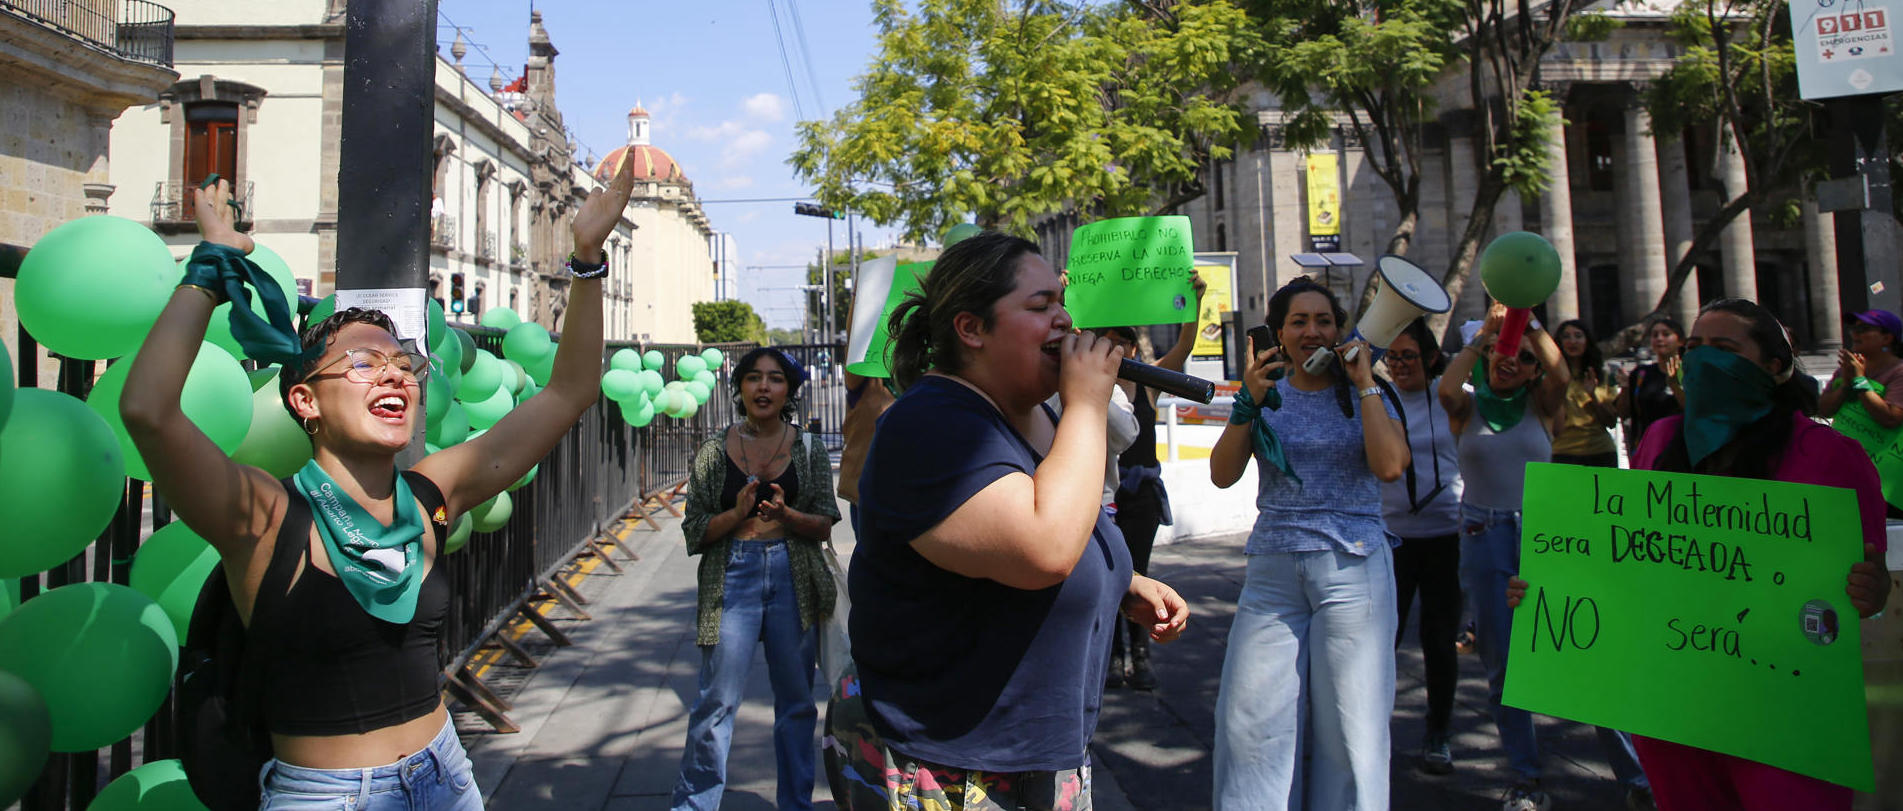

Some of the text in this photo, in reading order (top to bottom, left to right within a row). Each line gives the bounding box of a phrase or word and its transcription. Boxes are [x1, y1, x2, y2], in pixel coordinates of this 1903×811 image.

[1819, 12, 1881, 33] 911
[1820, 33, 1888, 47] EMERGENCIAS
[1080, 227, 1179, 247] PROHIBIRLO NO
[1132, 247, 1149, 260] LA
[1156, 245, 1186, 256] VIDA
[1069, 271, 1106, 286] NIEGA
[320, 482, 354, 528] Campaña
[1593, 474, 1813, 542] La Maternidad
[1533, 532, 1591, 556] sera
[1773, 571, 1785, 585] o
[1531, 586, 1601, 654] NO
